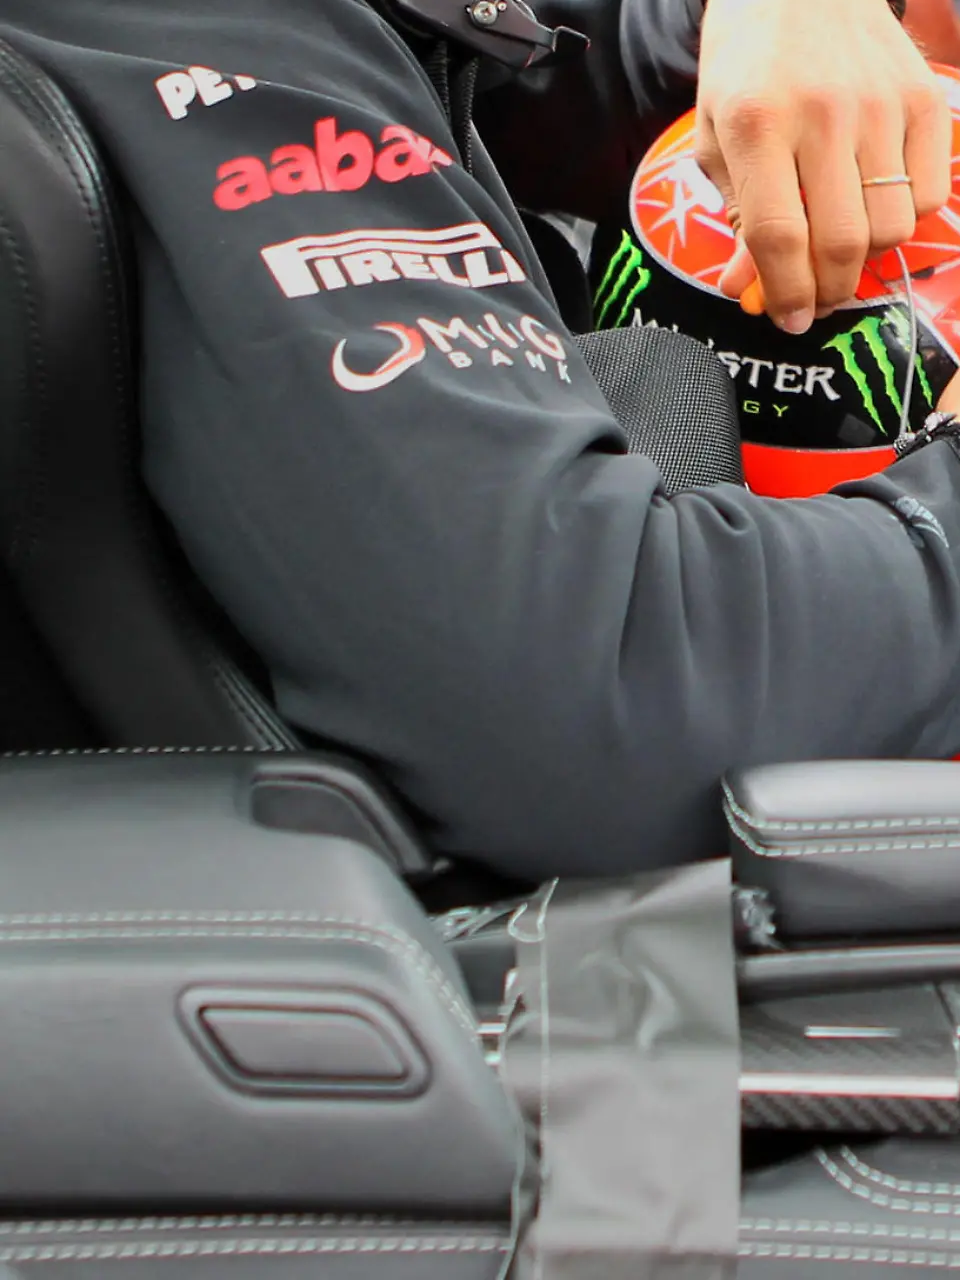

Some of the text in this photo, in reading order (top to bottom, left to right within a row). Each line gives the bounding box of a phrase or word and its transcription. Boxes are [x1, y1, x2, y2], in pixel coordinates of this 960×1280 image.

[260, 221, 526, 299] PIRELLI
[416, 311, 567, 362] MIG
[448, 348, 572, 385] BANK
